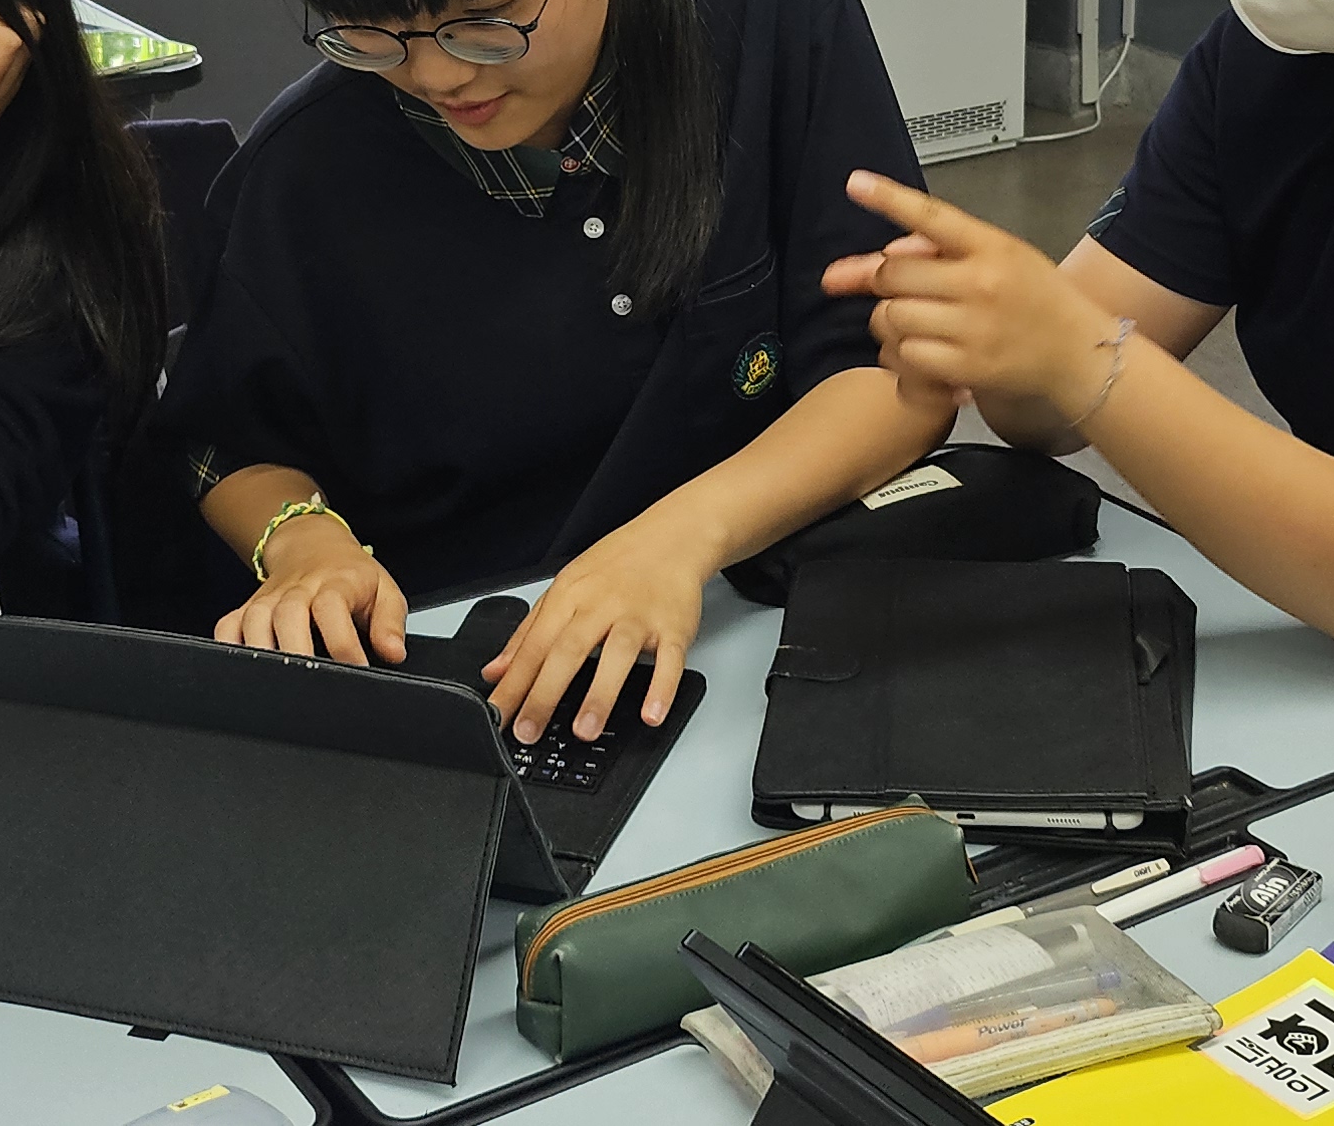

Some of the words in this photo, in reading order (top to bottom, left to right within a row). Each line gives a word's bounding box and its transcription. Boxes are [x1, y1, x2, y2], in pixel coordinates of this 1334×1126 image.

[878, 480, 939, 499] Campus
[1250, 877, 1290, 908] Ain
[978, 1017, 1029, 1037] Power
[1224, 1034, 1330, 1103] 내공의
